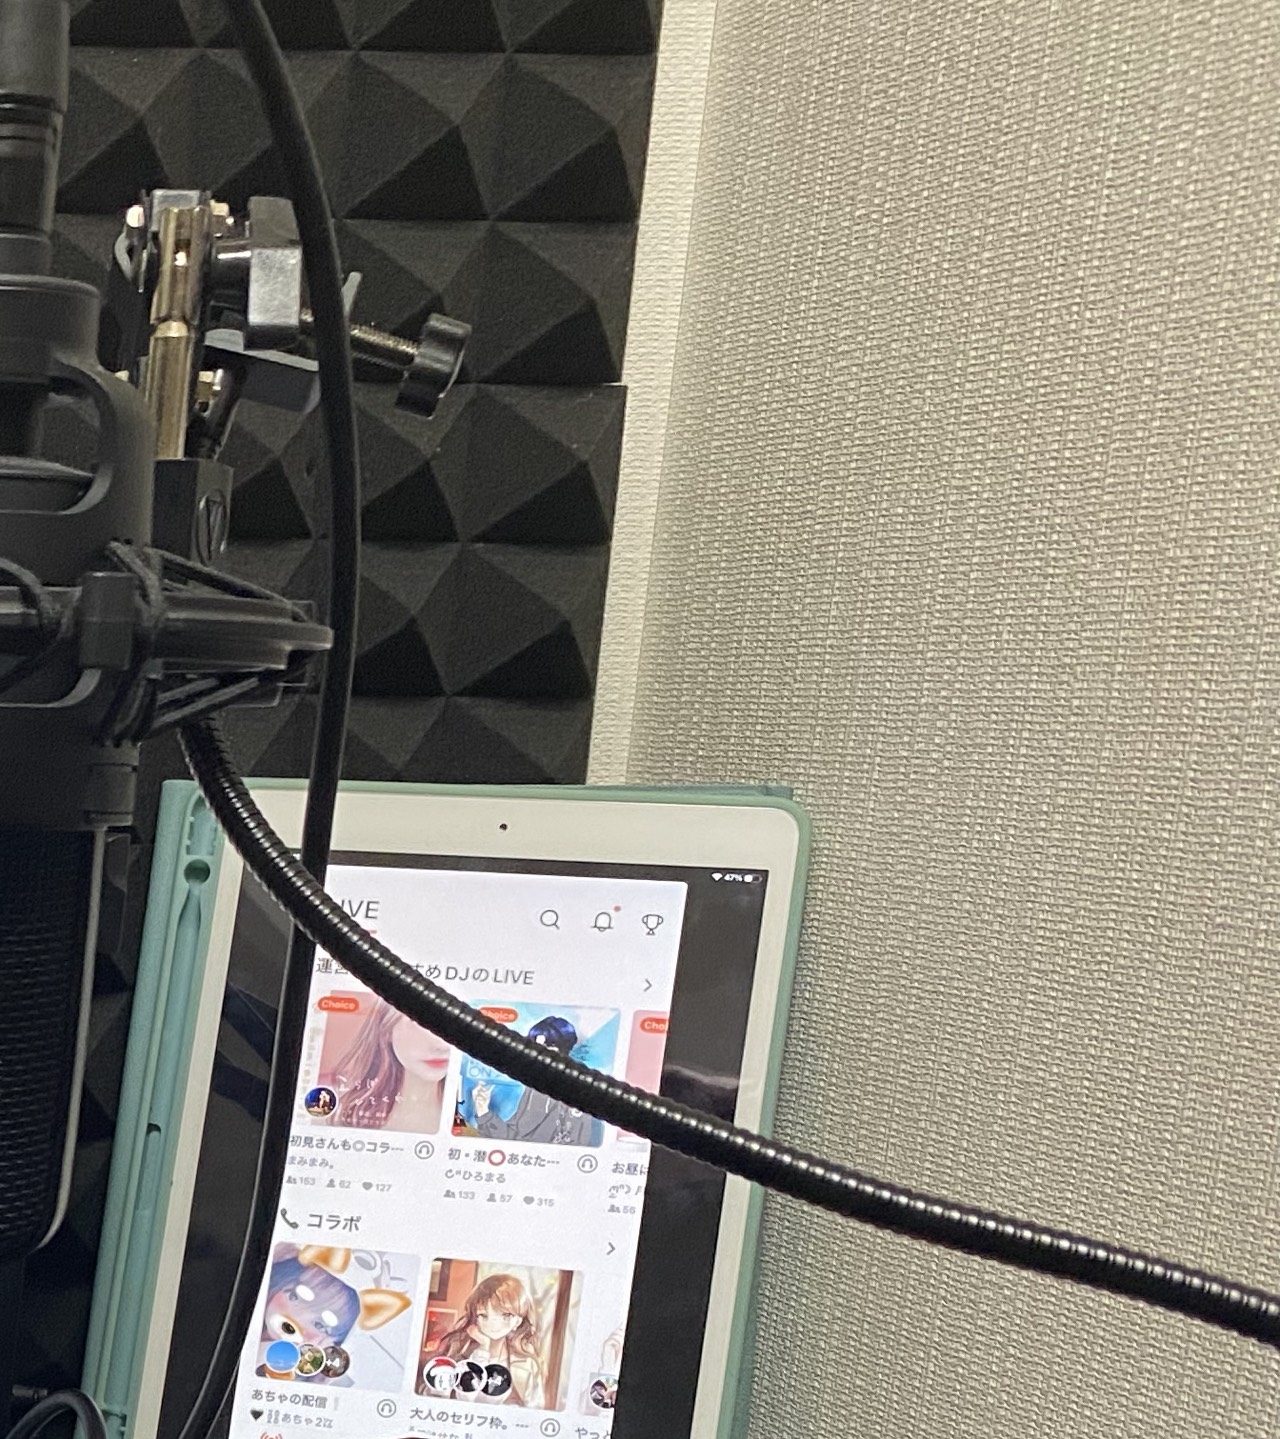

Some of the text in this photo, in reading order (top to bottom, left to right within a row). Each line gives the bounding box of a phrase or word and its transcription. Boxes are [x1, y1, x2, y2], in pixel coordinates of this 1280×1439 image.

[321, 999, 355, 1010] Choice
[375, 1183, 392, 1192] 127
[307, 1213, 362, 1232] コラボ
[252, 1388, 328, 1409] あちゃの配信
